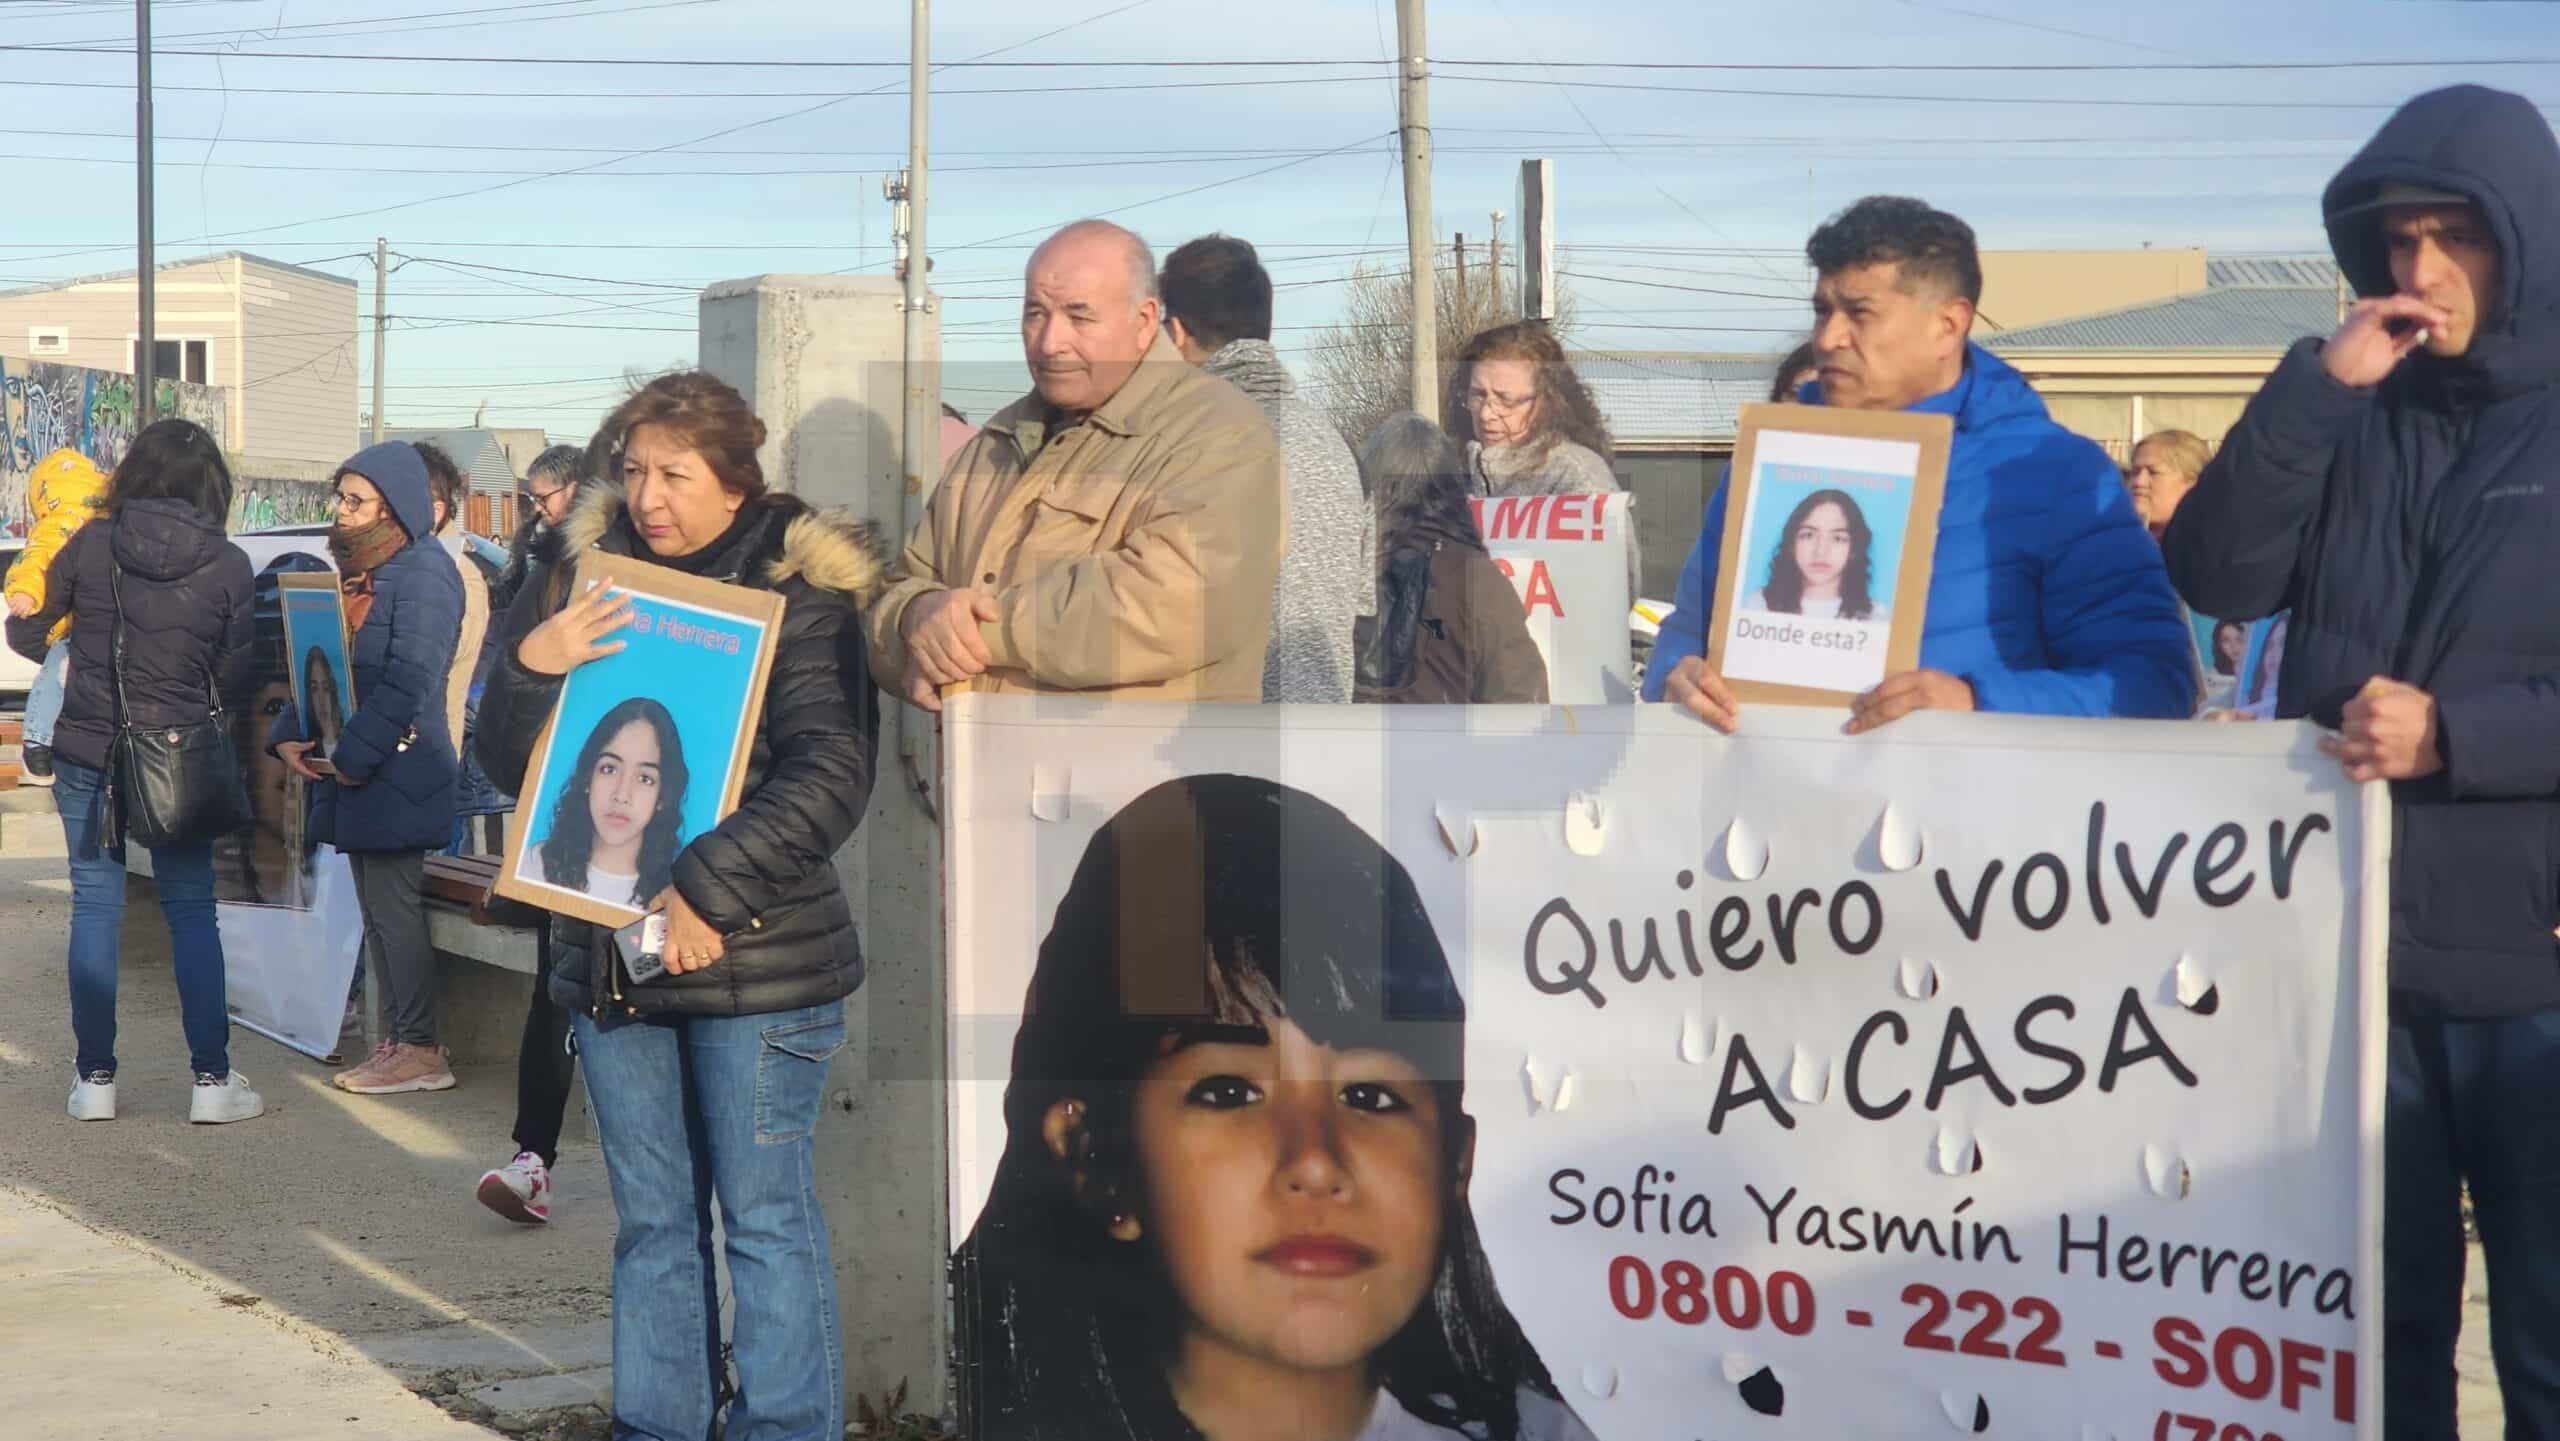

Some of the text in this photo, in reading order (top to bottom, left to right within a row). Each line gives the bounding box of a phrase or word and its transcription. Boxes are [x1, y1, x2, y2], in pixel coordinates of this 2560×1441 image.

[656, 612, 741, 655] Herrera
[1736, 617, 1869, 651] Donde esta?
[1525, 801, 2332, 1008] Quiero volver
[1707, 987, 2198, 1135] A CASA
[1548, 1164, 2357, 1322] Sofia Yasmín Herrera
[1609, 1255, 1817, 1338] 0800
[1900, 1283, 2068, 1367] 222
[2152, 1315, 2358, 1426] SOFI
